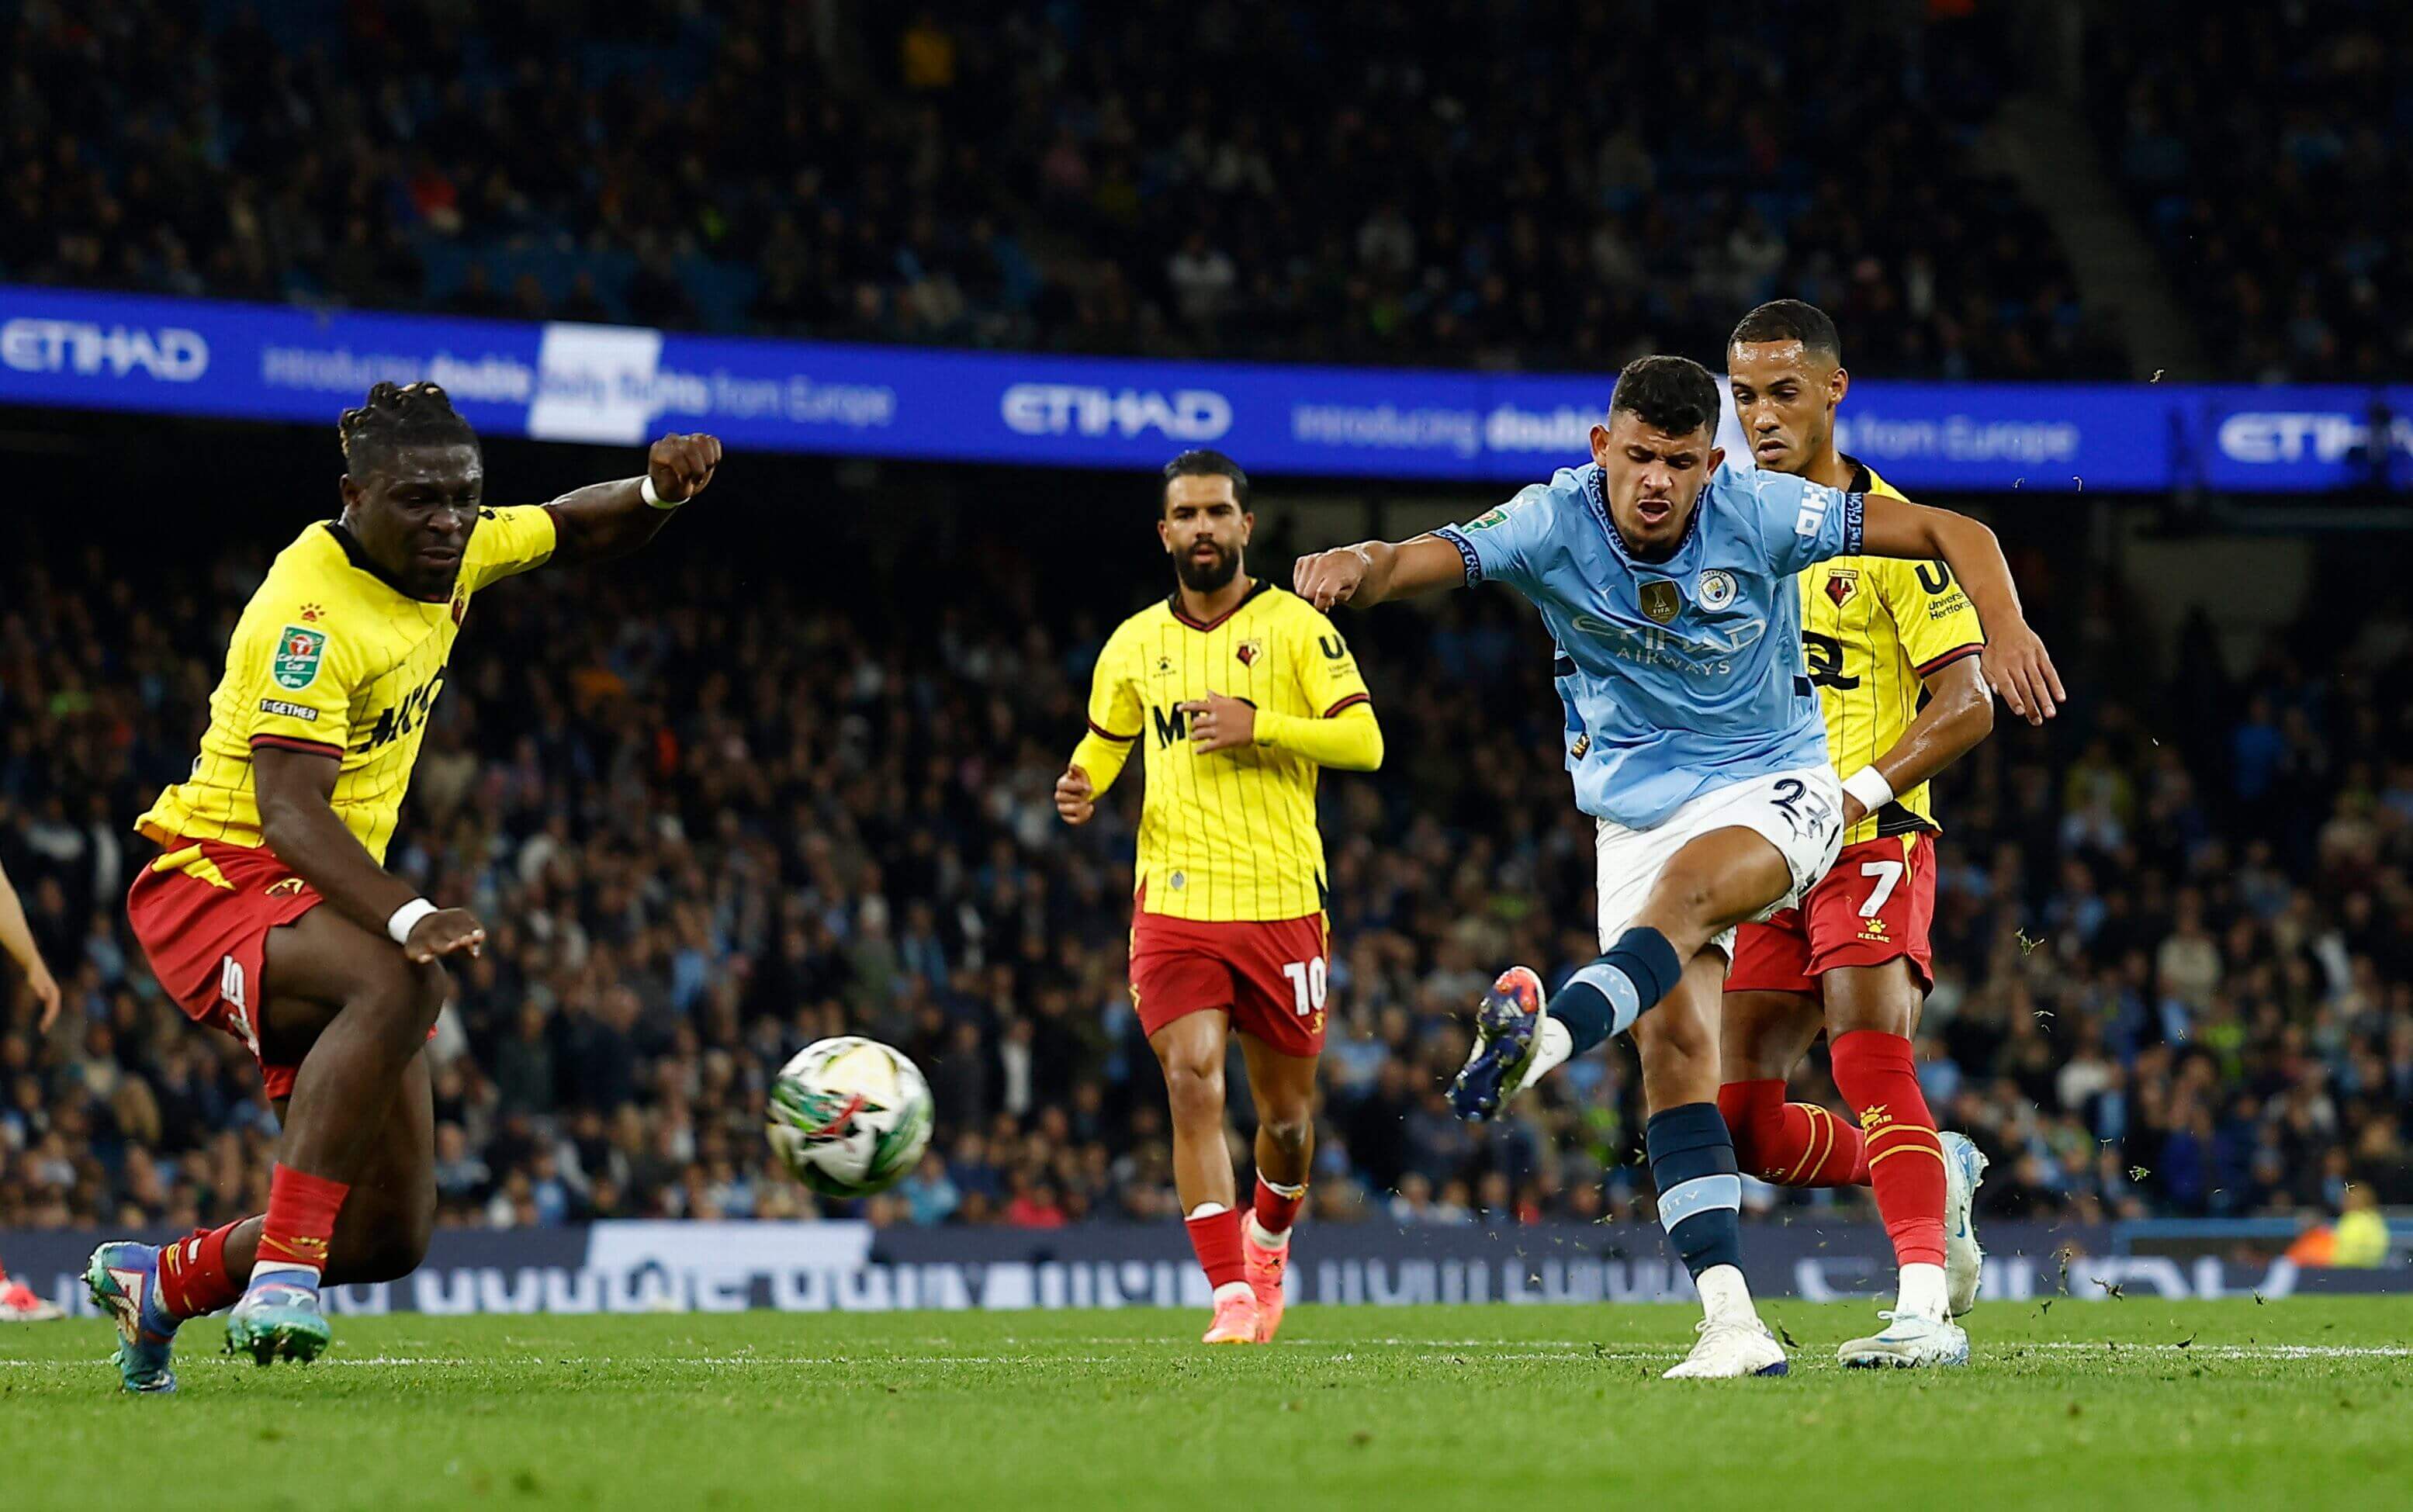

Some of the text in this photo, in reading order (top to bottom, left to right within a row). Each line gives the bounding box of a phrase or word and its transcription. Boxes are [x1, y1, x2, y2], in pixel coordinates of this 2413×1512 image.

[0, 317, 209, 381] ETIHAD
[1001, 383, 1234, 441] ETIHAD
[1943, 414, 2082, 465] Europe
[1616, 647, 1732, 677] AIRWAYS
[1858, 860, 1904, 918] 7
[1857, 932, 1891, 944] KELME
[1283, 956, 1327, 1017] 10
